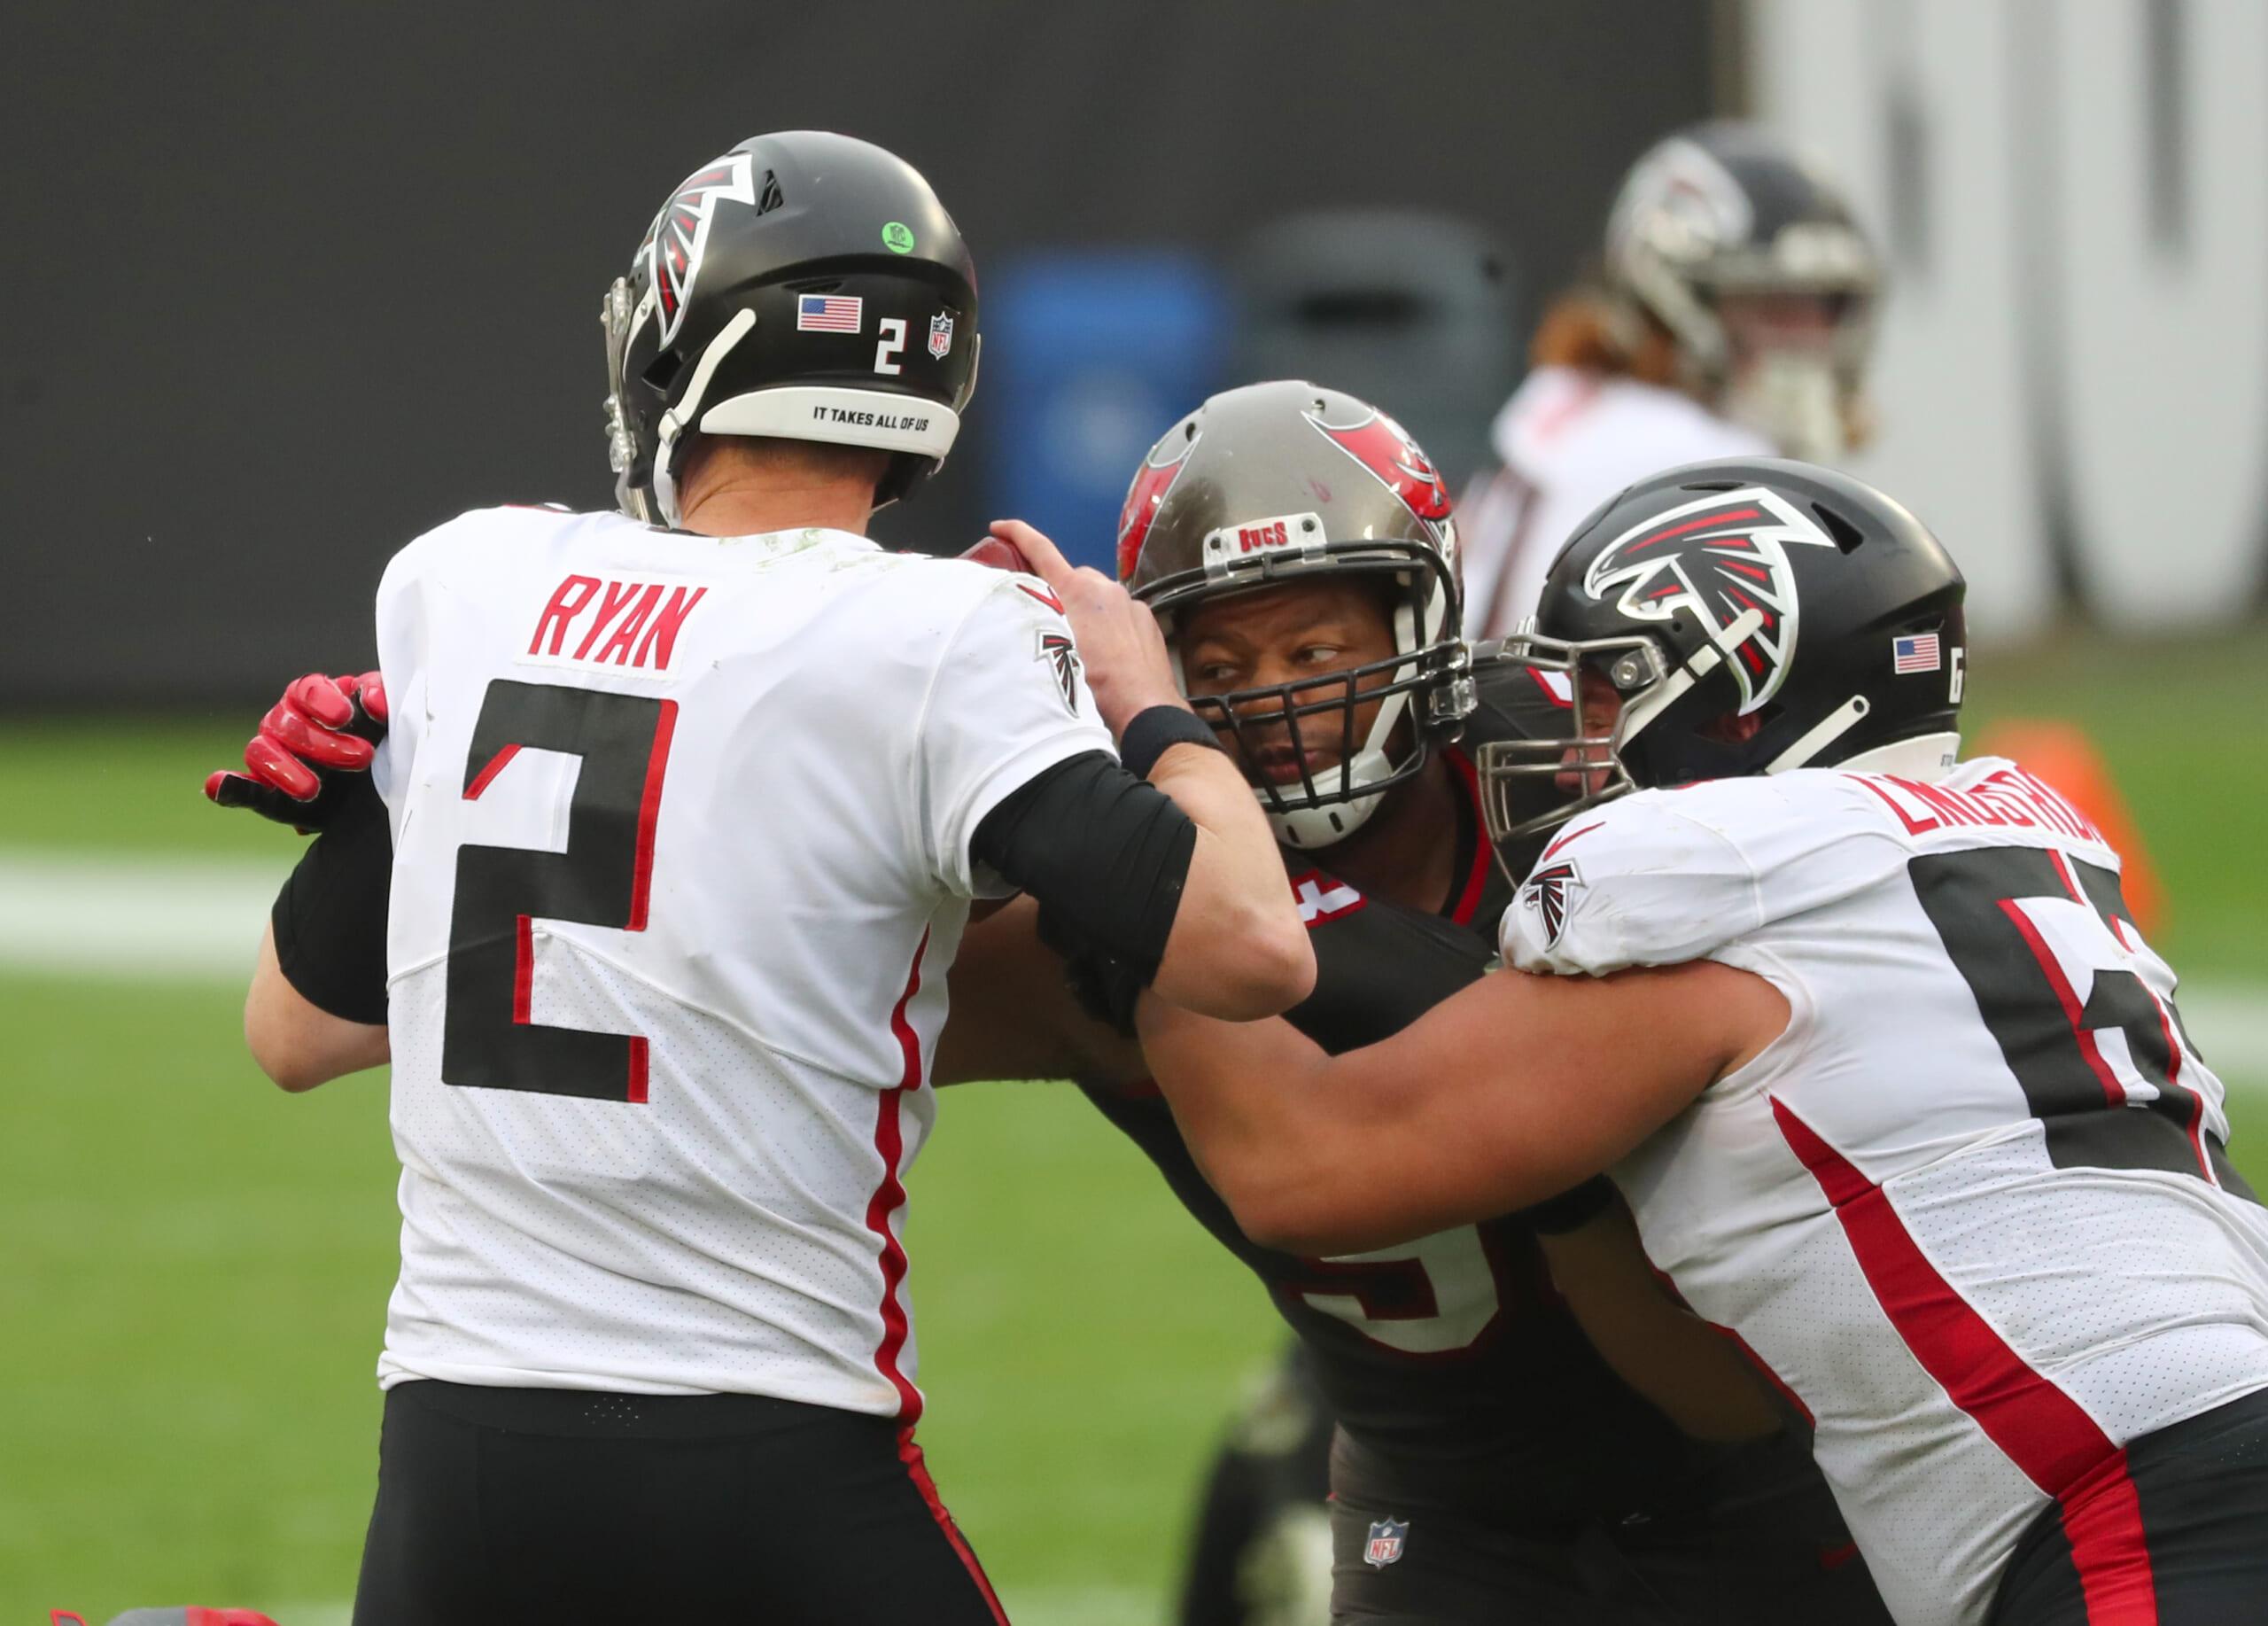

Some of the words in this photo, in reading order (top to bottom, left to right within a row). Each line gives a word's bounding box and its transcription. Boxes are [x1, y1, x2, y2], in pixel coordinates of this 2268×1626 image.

[874, 317, 906, 375] 2
[932, 331, 948, 352] NFL
[813, 406, 827, 420] IT
[831, 408, 874, 426] TAKES
[875, 415, 897, 429] ALL
[900, 417, 915, 431] OF
[915, 418, 929, 432] US
[527, 573, 709, 671] RYAN
[441, 679, 679, 1104] 2
[1369, 1537, 1400, 1560] NFL
